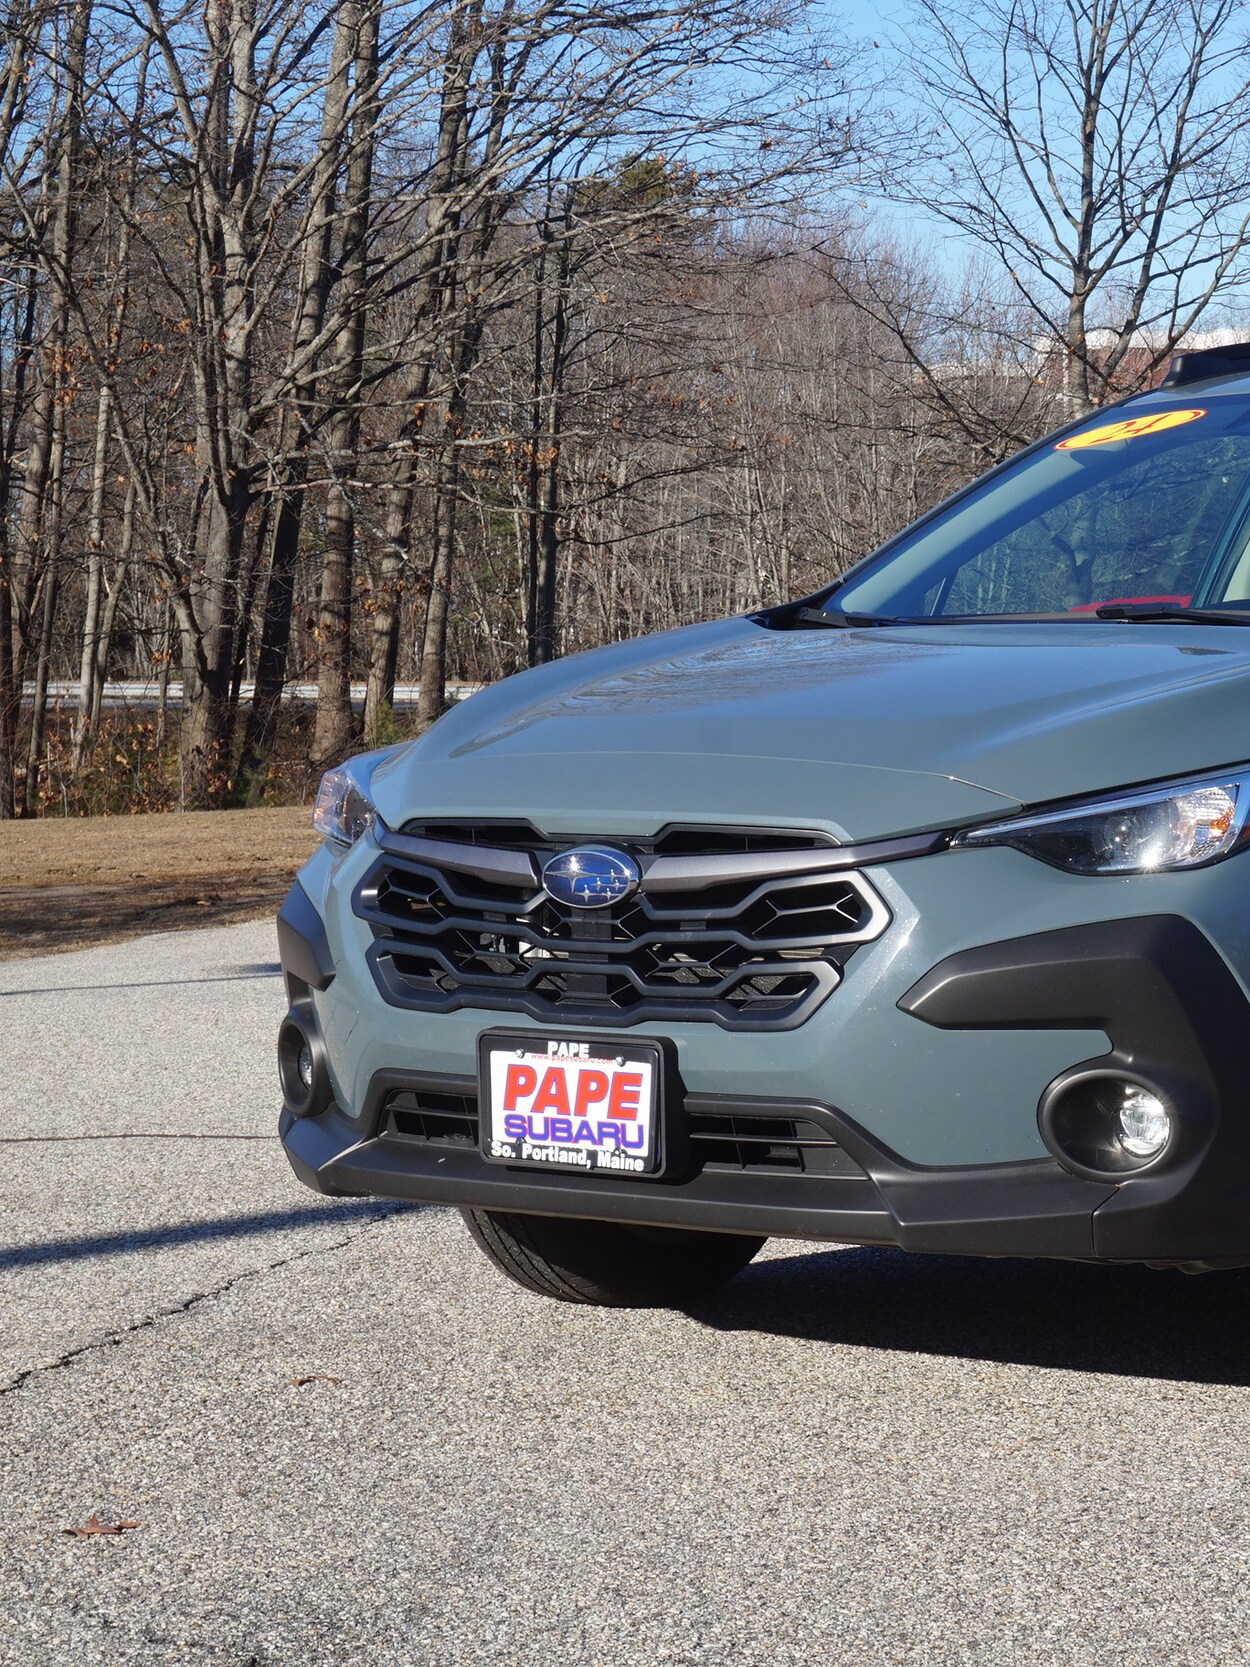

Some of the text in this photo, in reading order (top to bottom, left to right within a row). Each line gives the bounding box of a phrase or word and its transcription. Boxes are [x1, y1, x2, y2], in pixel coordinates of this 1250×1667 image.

[1087, 413, 1172, 444] 24
[530, 1054, 613, 1065] www.papesubaru.com
[548, 1041, 590, 1058] PAPE
[503, 1063, 643, 1121] PAPE
[504, 1113, 644, 1149] SUBARU
[490, 1140, 645, 1172] So. Portland, Maine
